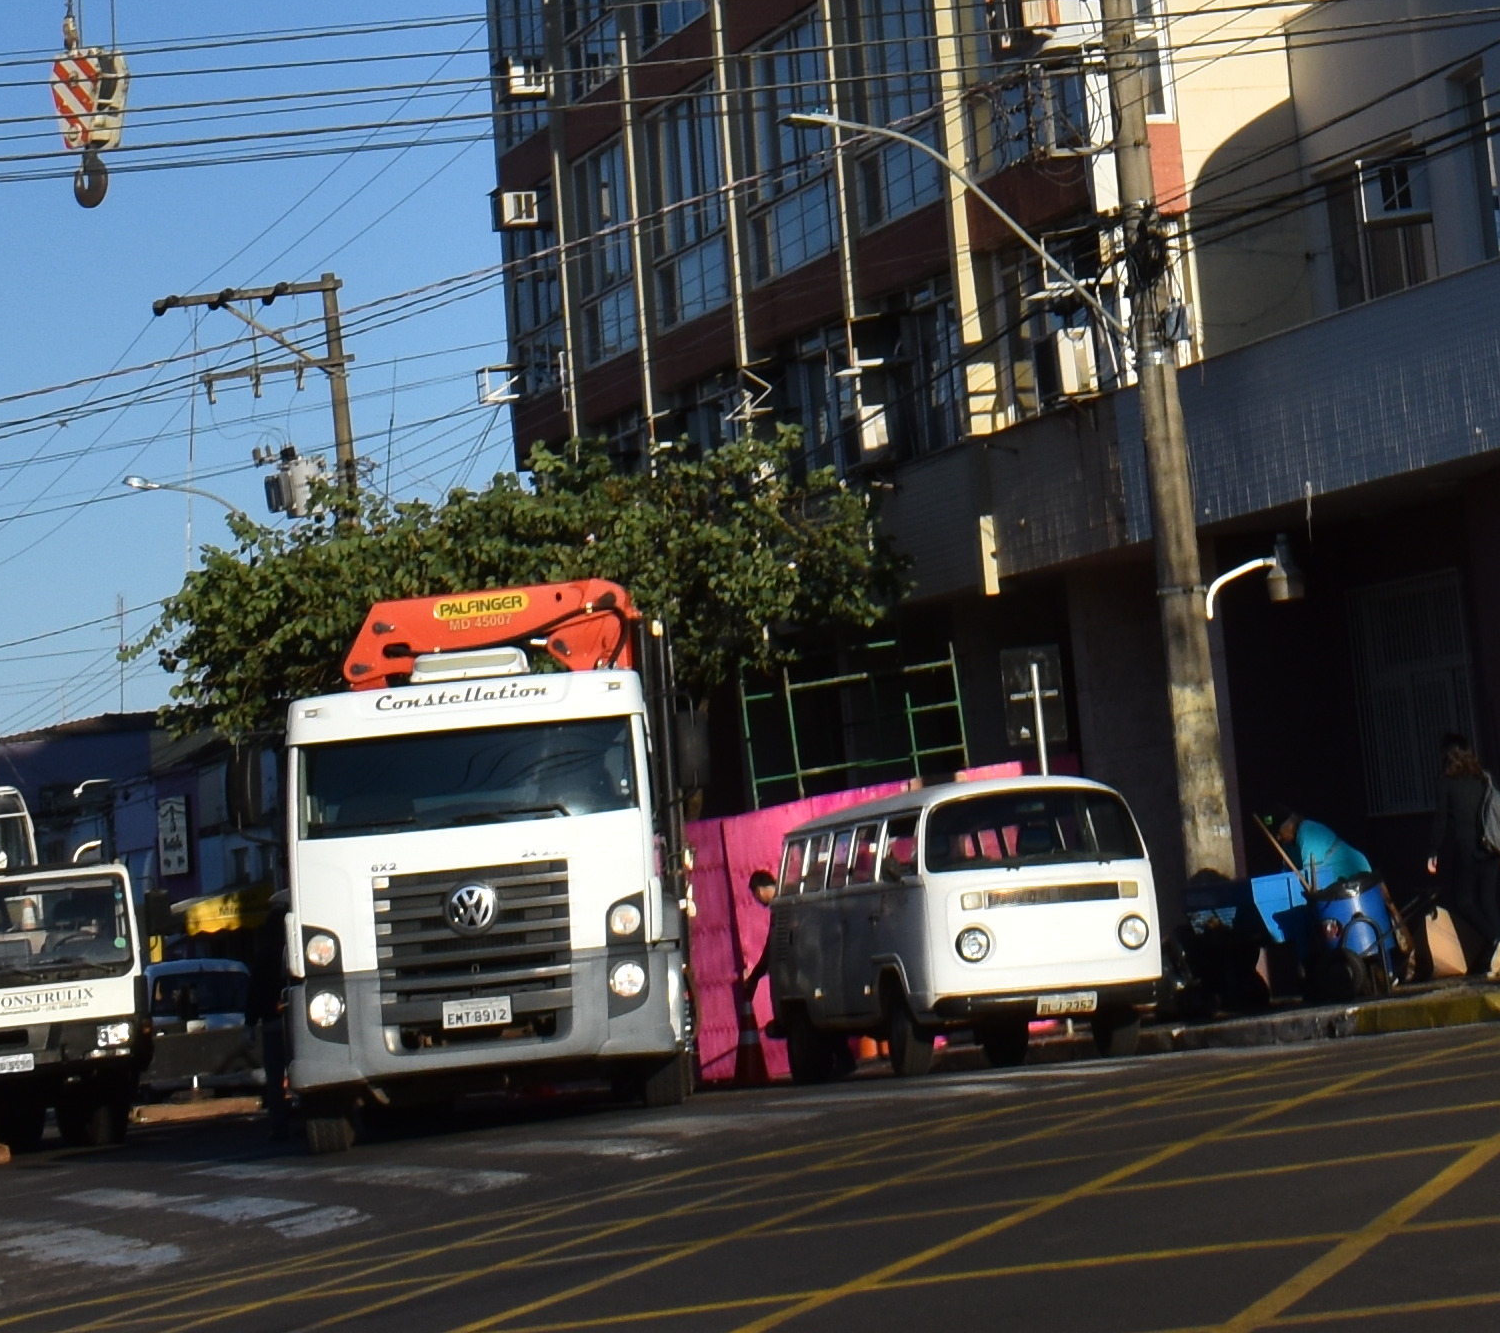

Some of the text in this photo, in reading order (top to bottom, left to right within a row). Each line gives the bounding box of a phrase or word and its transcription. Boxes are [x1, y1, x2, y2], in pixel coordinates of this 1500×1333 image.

[440, 595, 523, 617] PALFINGER
[449, 619, 471, 631] MD
[375, 682, 550, 711] Constellation
